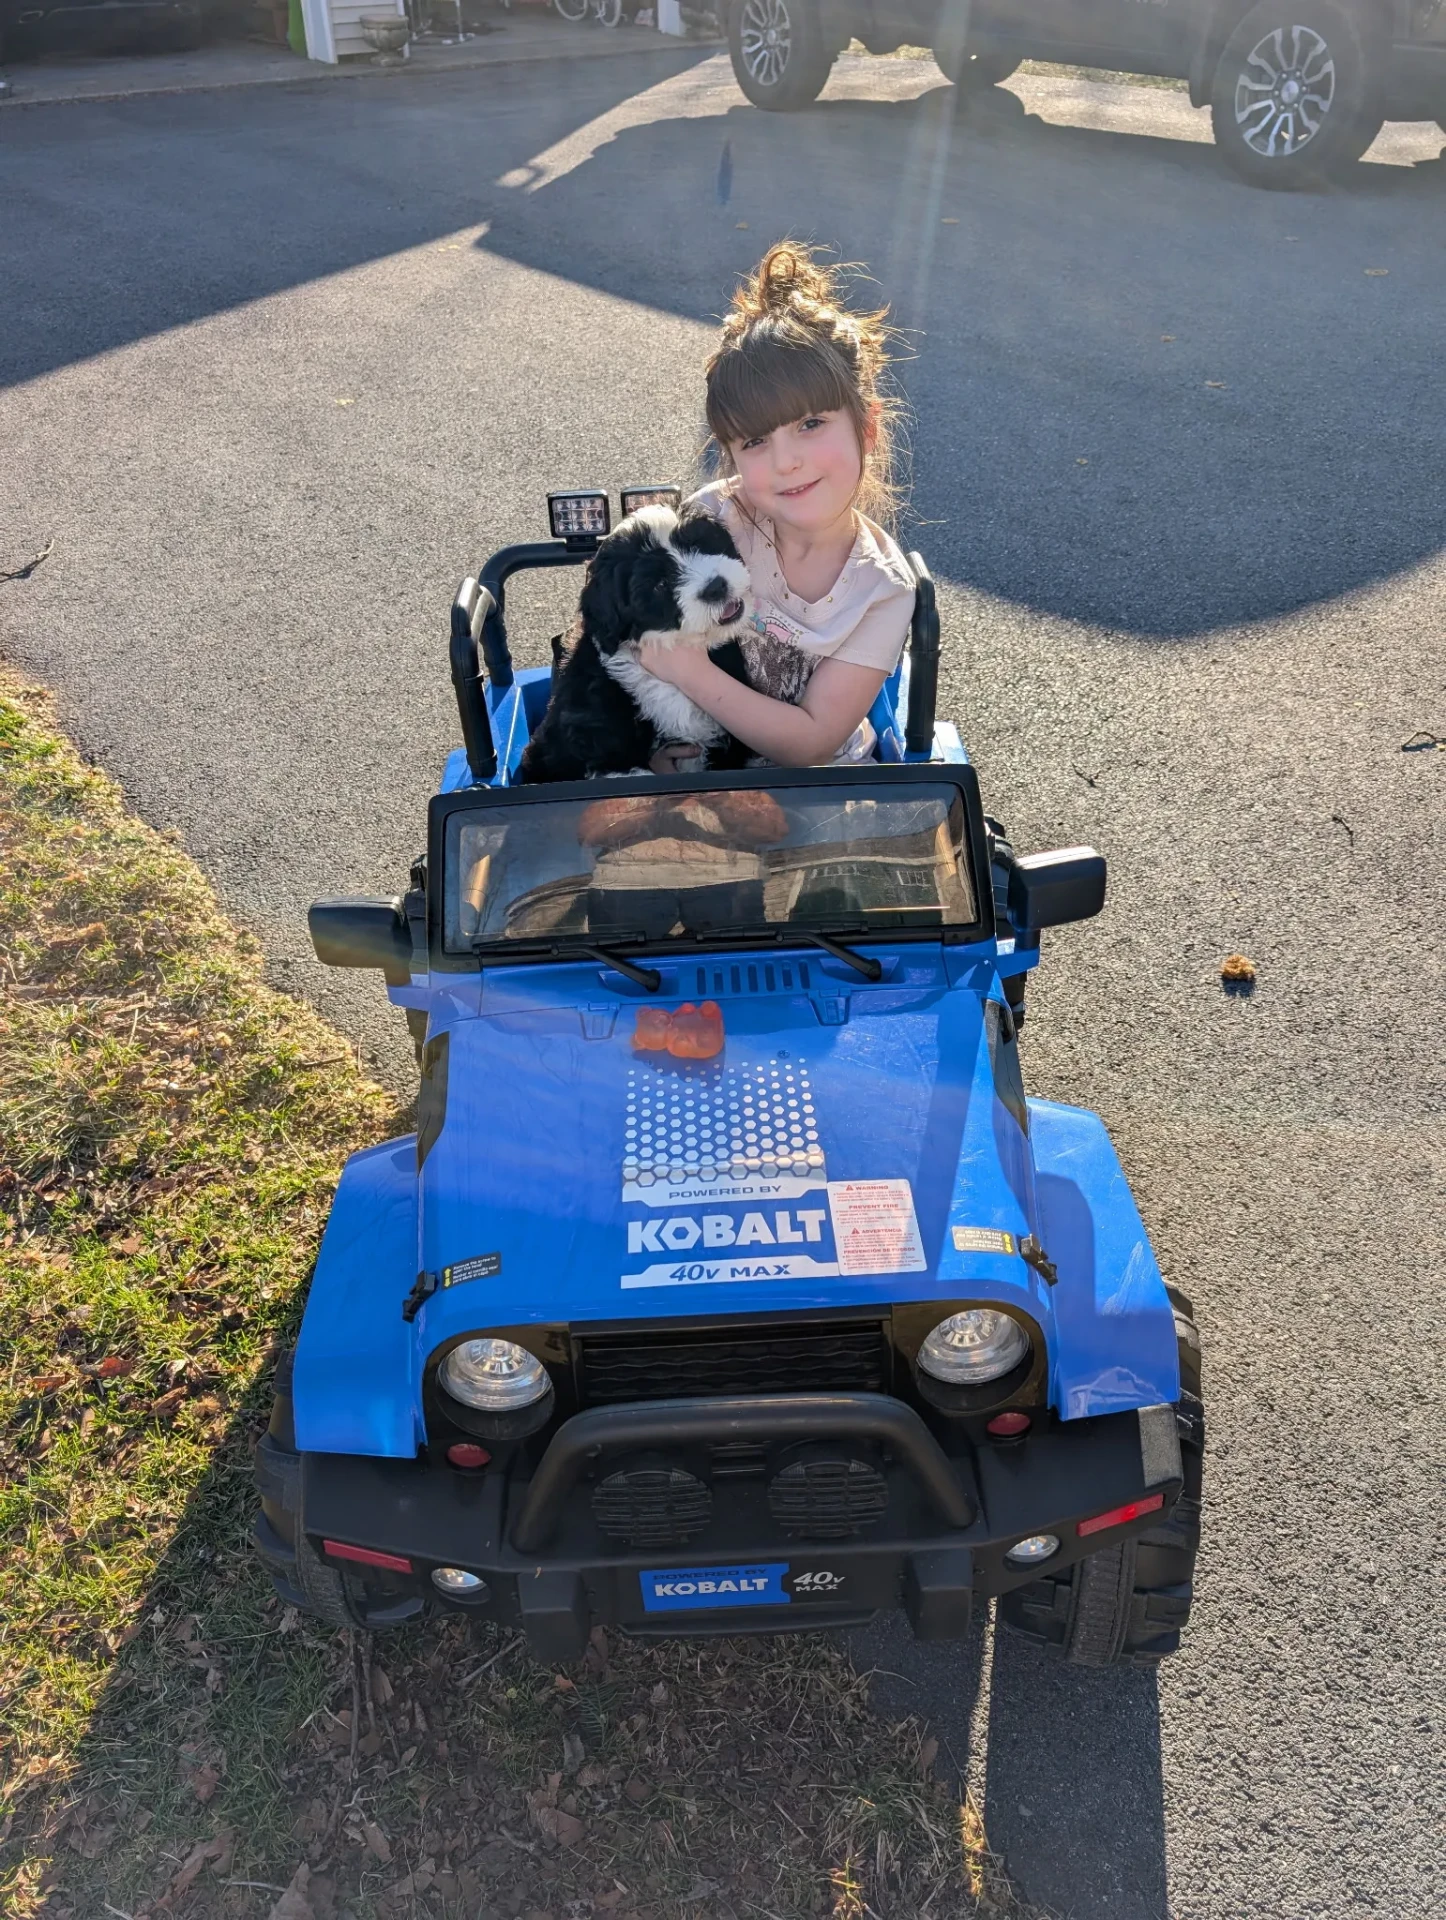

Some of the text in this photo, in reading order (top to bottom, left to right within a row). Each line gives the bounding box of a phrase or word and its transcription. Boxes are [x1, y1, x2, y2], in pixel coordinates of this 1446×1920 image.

[668, 1185, 782, 1200] POWERED BY
[627, 1209, 826, 1254] KOBALT
[729, 1264, 792, 1278] MAX
[653, 1568, 768, 1580] POWERED BY
[654, 1578, 769, 1597] KOBALT
[795, 1584, 839, 1592] MAX
